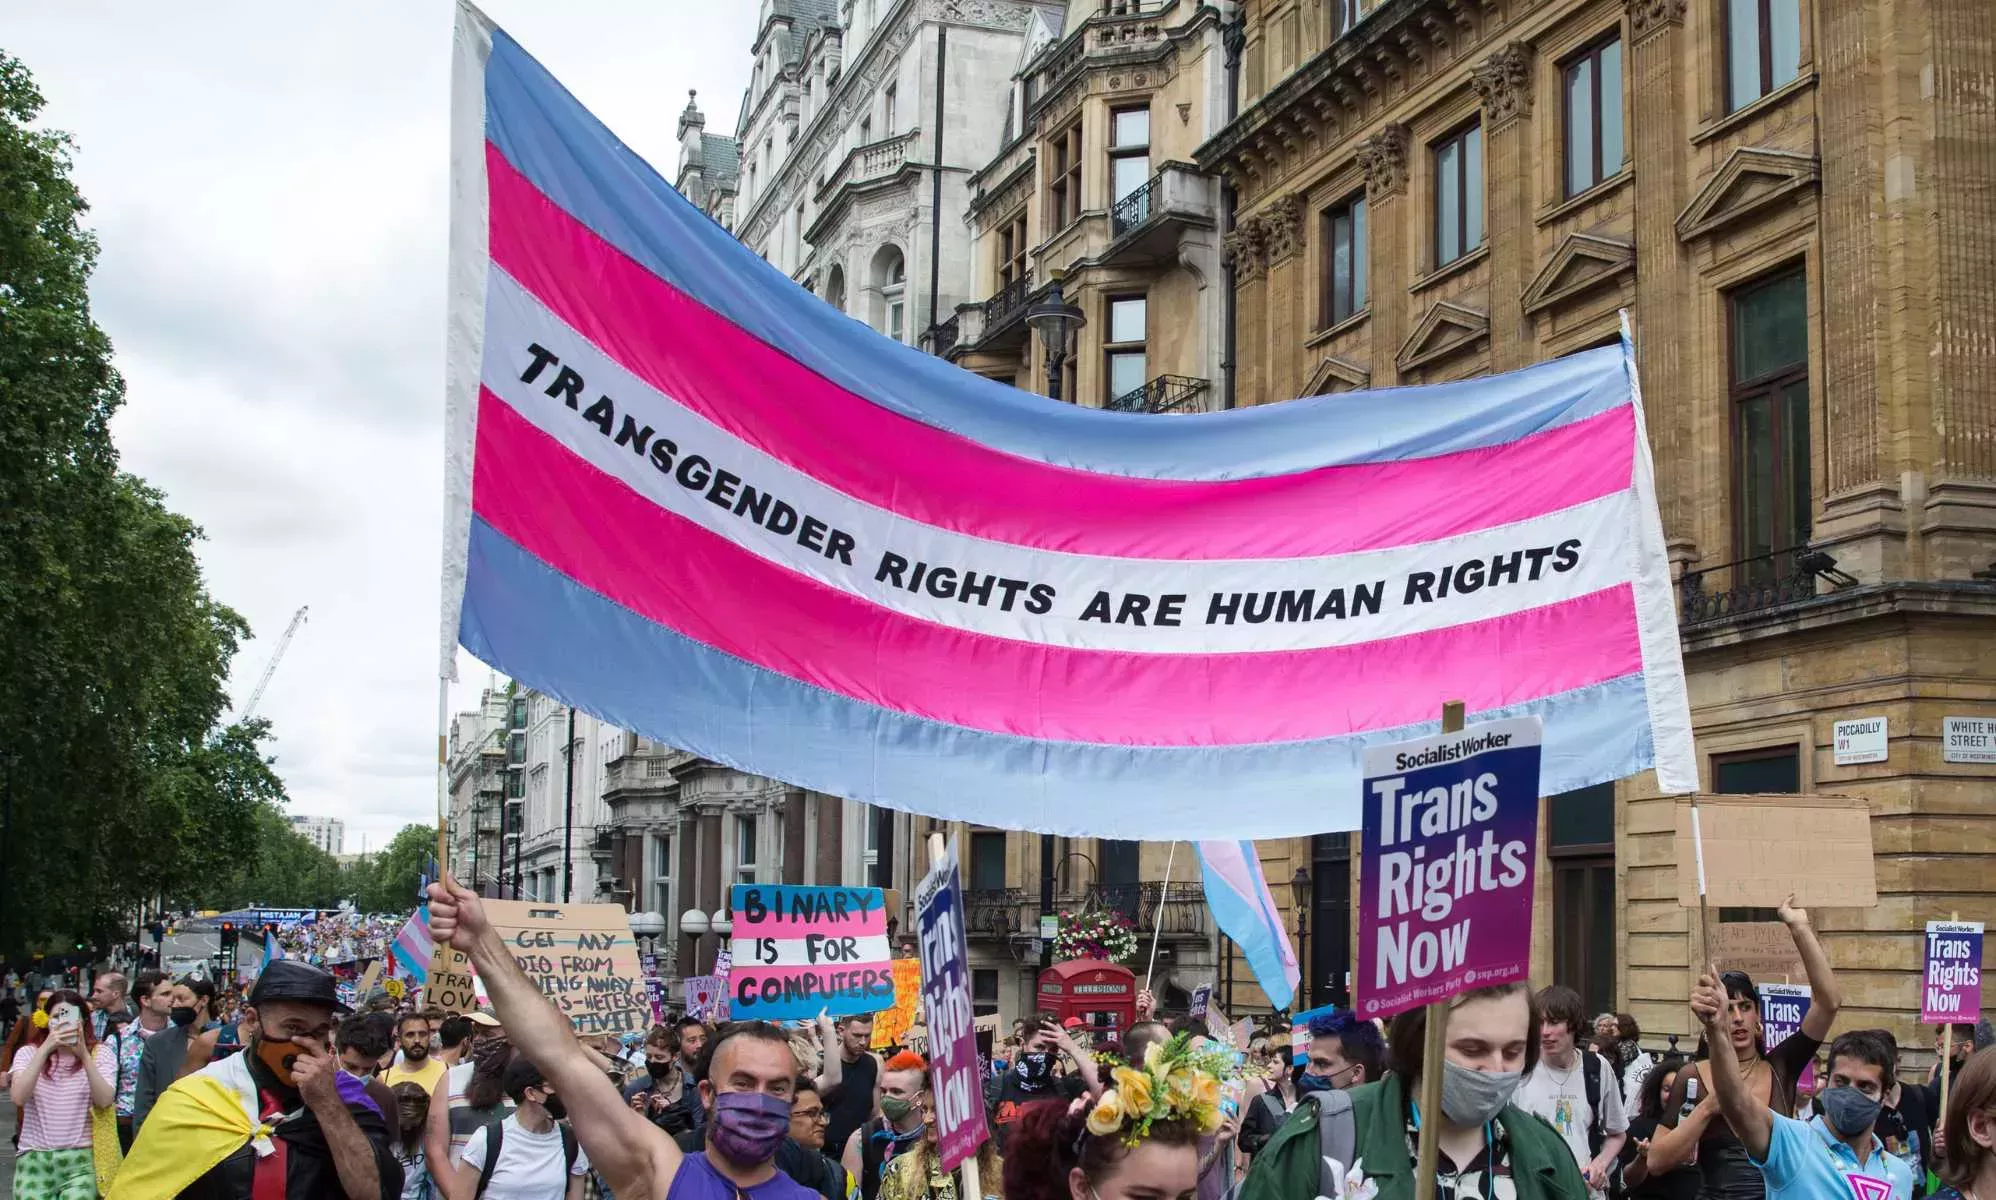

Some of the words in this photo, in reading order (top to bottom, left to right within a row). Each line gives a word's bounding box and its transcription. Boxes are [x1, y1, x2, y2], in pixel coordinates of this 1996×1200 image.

[520, 343, 856, 566] TRANSGENDER
[874, 551, 1056, 615] RIGHTS
[1078, 591, 1187, 627] ARE
[1205, 580, 1386, 625] HUMAN
[1403, 538, 1582, 605] RIGHTS
[1838, 721, 1881, 737] PICCADILLY
[1951, 721, 1983, 734] WHITE
[1951, 735, 1988, 747] STREET
[1396, 745, 1461, 771] Socialist
[1462, 731, 1512, 757] Worker
[1838, 738, 1850, 751] W1
[1372, 772, 1498, 847] Trans
[1378, 829, 1527, 922] Rights
[744, 888, 873, 924] BINARY
[516, 930, 556, 949] GET
[577, 932, 616, 951] MY
[755, 937, 778, 965] IS
[806, 933, 860, 966] FOR
[1375, 918, 1471, 990] Now
[1928, 933, 1971, 959] Trans
[519, 955, 552, 974] DIO
[560, 956, 614, 976] FROM
[1928, 960, 1979, 991] Rights
[587, 977, 634, 994] AWAY
[737, 969, 894, 1007] COMPUTERS
[552, 992, 648, 1011] S-HETERO
[1762, 995, 1801, 1023] Trans
[1926, 987, 1961, 1012] Now
